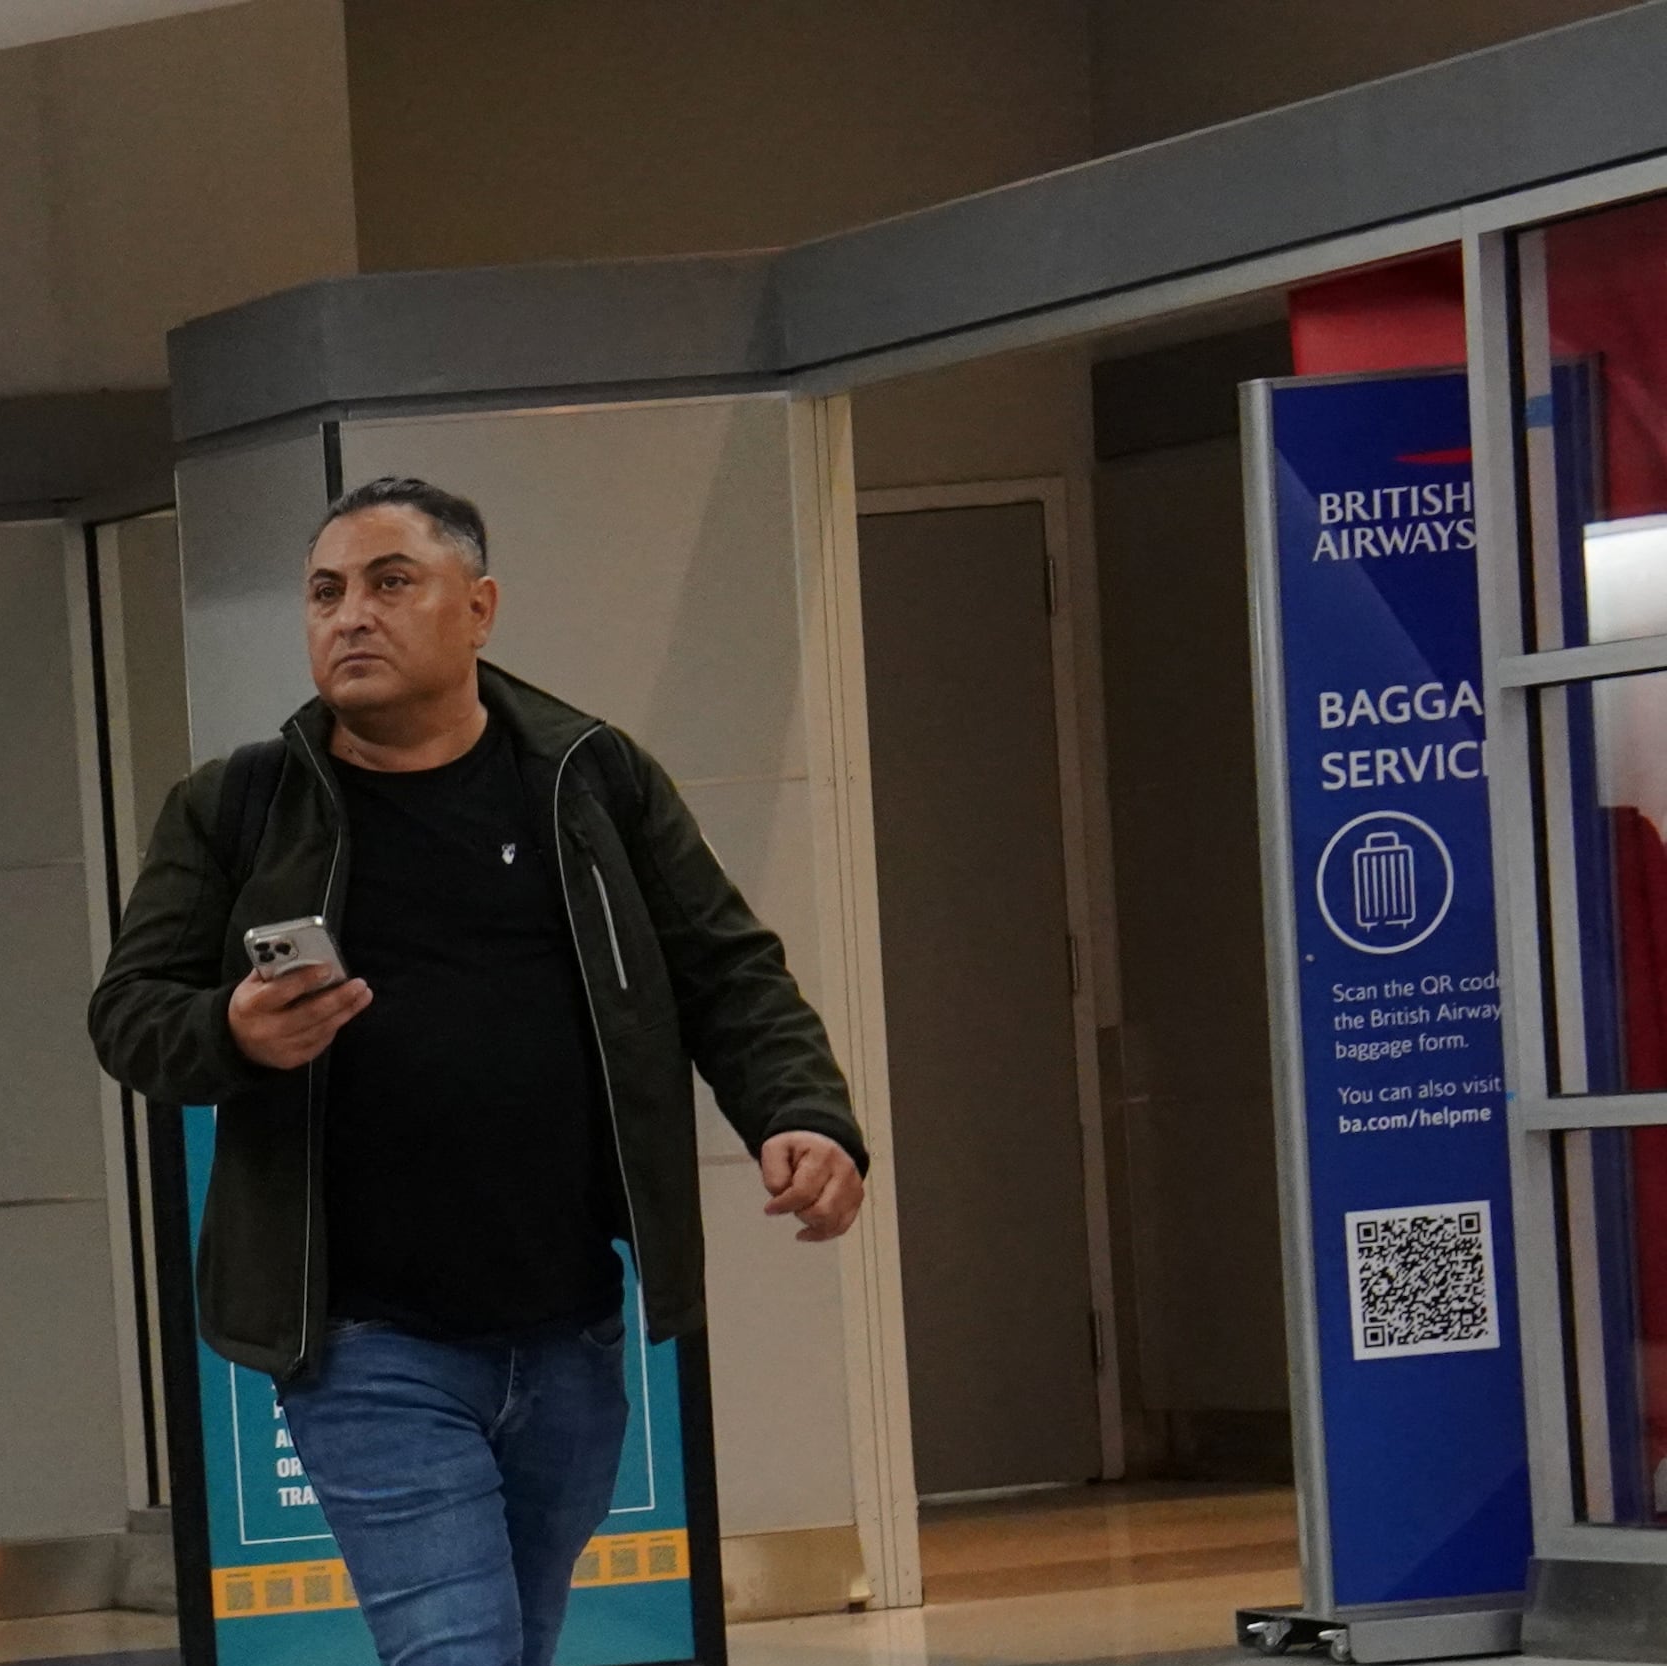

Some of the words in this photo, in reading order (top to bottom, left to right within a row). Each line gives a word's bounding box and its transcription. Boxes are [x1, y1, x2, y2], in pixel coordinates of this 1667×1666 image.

[1320, 481, 1472, 524] BRITISH
[1313, 519, 1476, 562] AIRWAYS
[1332, 983, 1377, 1003] Scan
[1383, 979, 1415, 998] the
[1420, 975, 1454, 995] QR
[1334, 1012, 1365, 1031] the
[1370, 1005, 1430, 1028] British
[1335, 1038, 1413, 1062] baggage
[1419, 1032, 1469, 1051] form.
[1338, 1086, 1373, 1104] You
[1378, 1085, 1412, 1101] can
[1418, 1079, 1456, 1099] also
[1462, 1074, 1503, 1094] visit
[1339, 1106, 1492, 1134] ba.com/helpme
